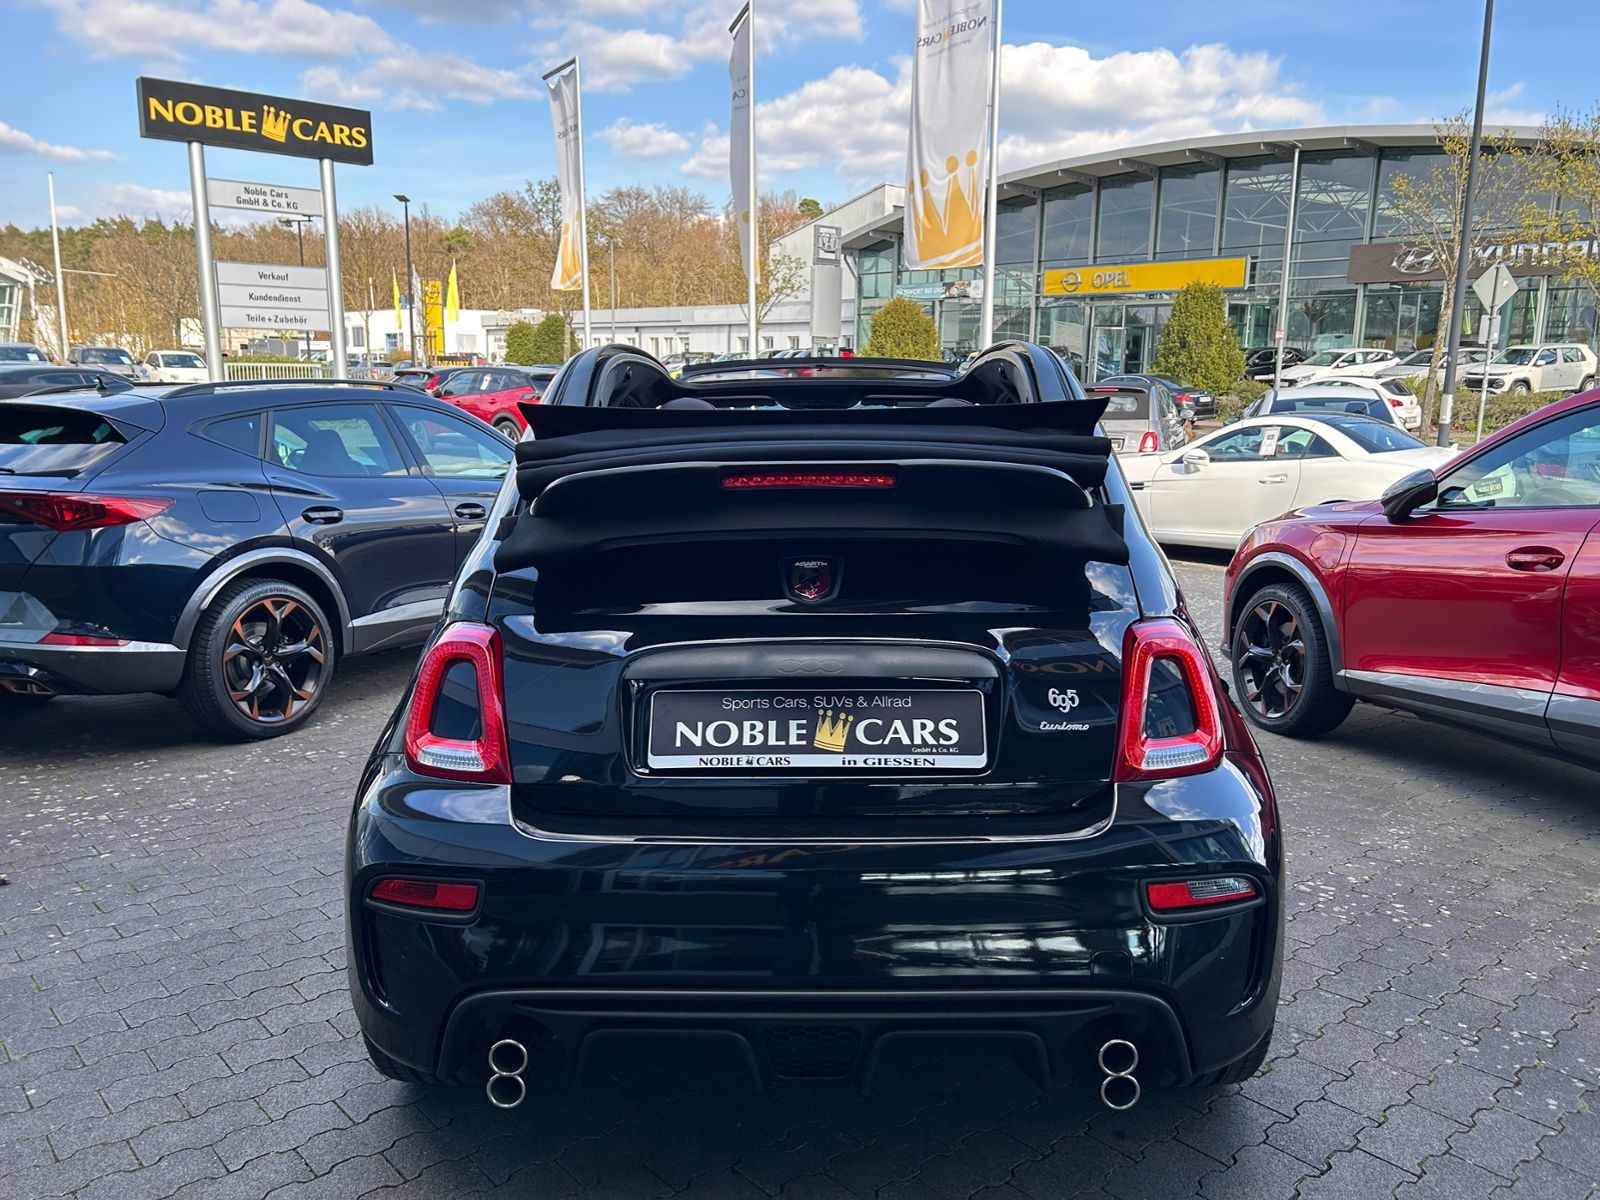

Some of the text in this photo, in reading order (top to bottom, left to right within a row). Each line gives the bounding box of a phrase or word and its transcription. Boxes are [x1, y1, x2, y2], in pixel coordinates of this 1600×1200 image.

[148, 96, 368, 149] NOBLE CARS
[243, 186, 289, 199] Noble Cars
[236, 196, 299, 210] GmbH & Co. KG
[258, 271, 289, 281] Verkauf
[1091, 269, 1132, 289] OPEL
[248, 292, 301, 303] Kundendienst
[721, 695, 912, 711] Sports Cars, SUVs & Allrad
[1047, 687, 1080, 713] 695
[674, 718, 960, 748] NOBLE CARS
[698, 756, 791, 767] NOBLE CARS
[841, 756, 936, 767] in GIESSEN
